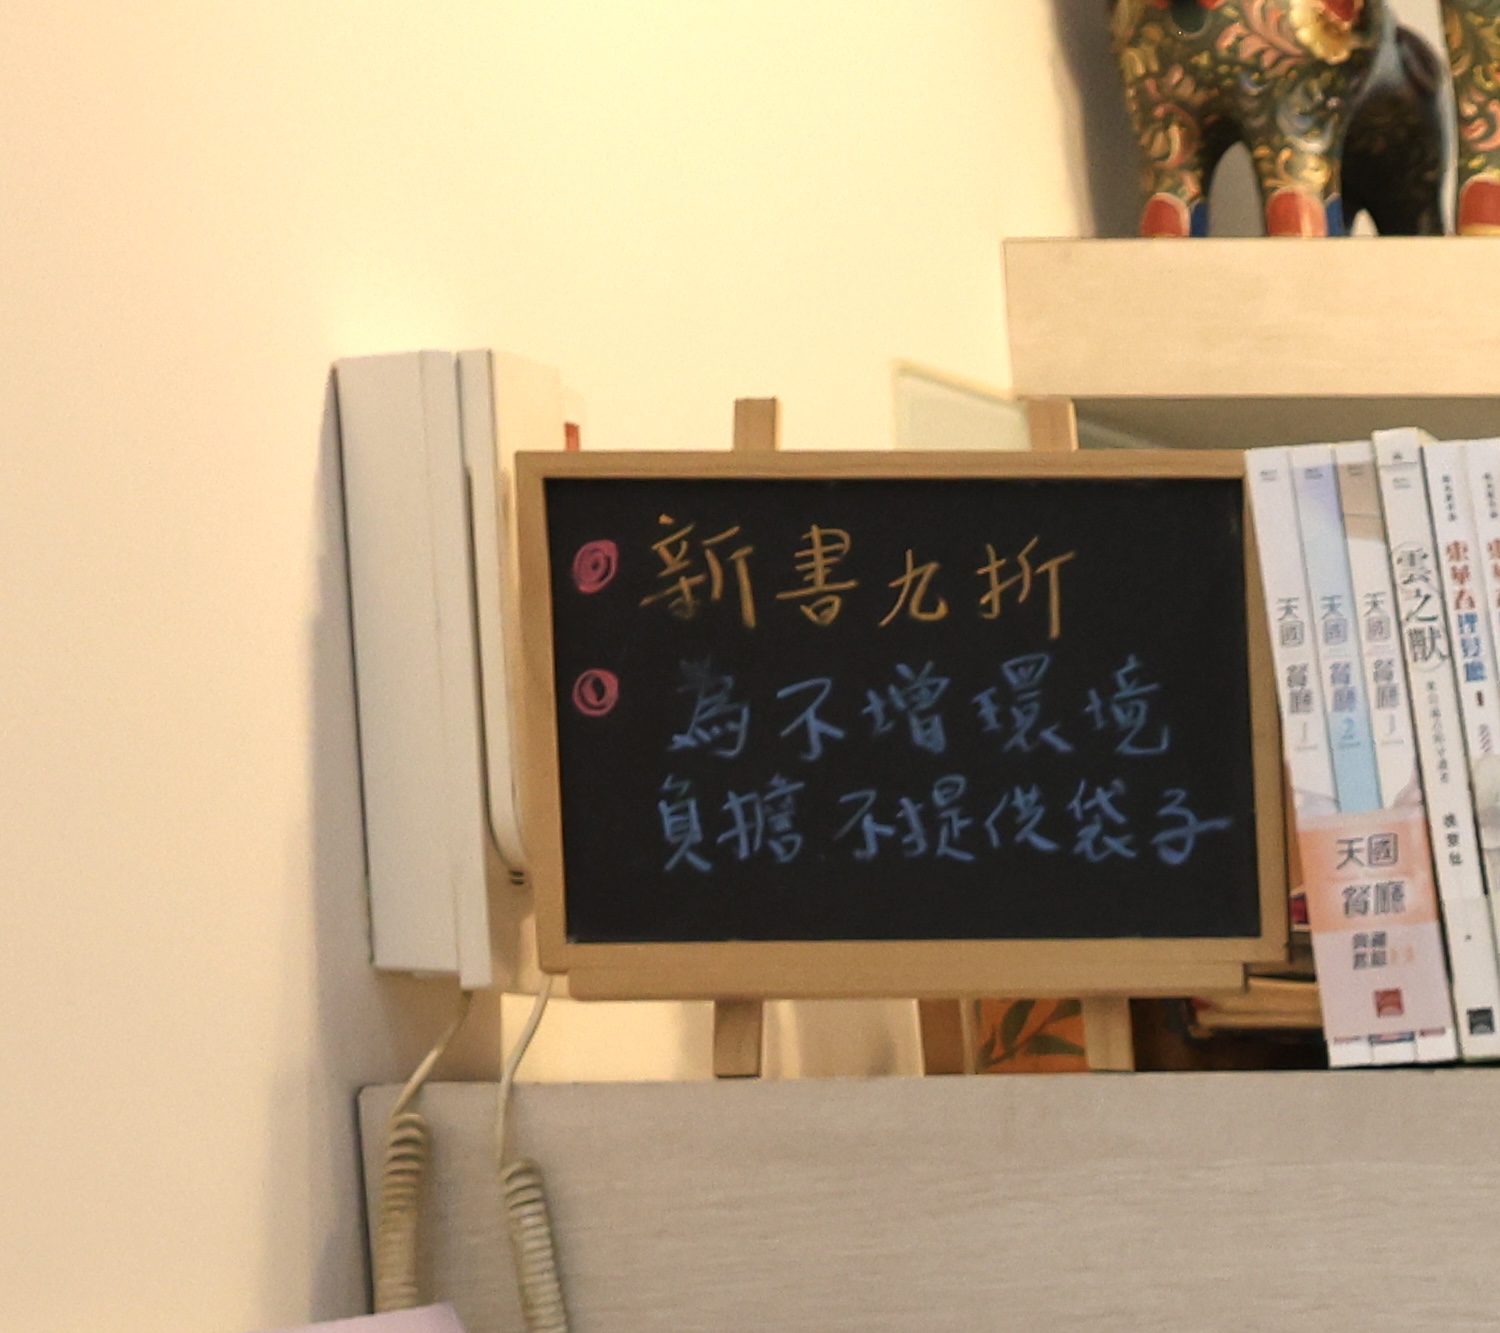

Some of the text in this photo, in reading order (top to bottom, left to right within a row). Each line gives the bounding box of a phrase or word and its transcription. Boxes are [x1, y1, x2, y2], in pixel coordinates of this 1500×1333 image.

[639, 513, 1076, 640] 新書九折
[1396, 547, 1449, 662] 雲之獸
[669, 652, 1170, 760] 為不增環境
[1336, 833, 1398, 869] 天國
